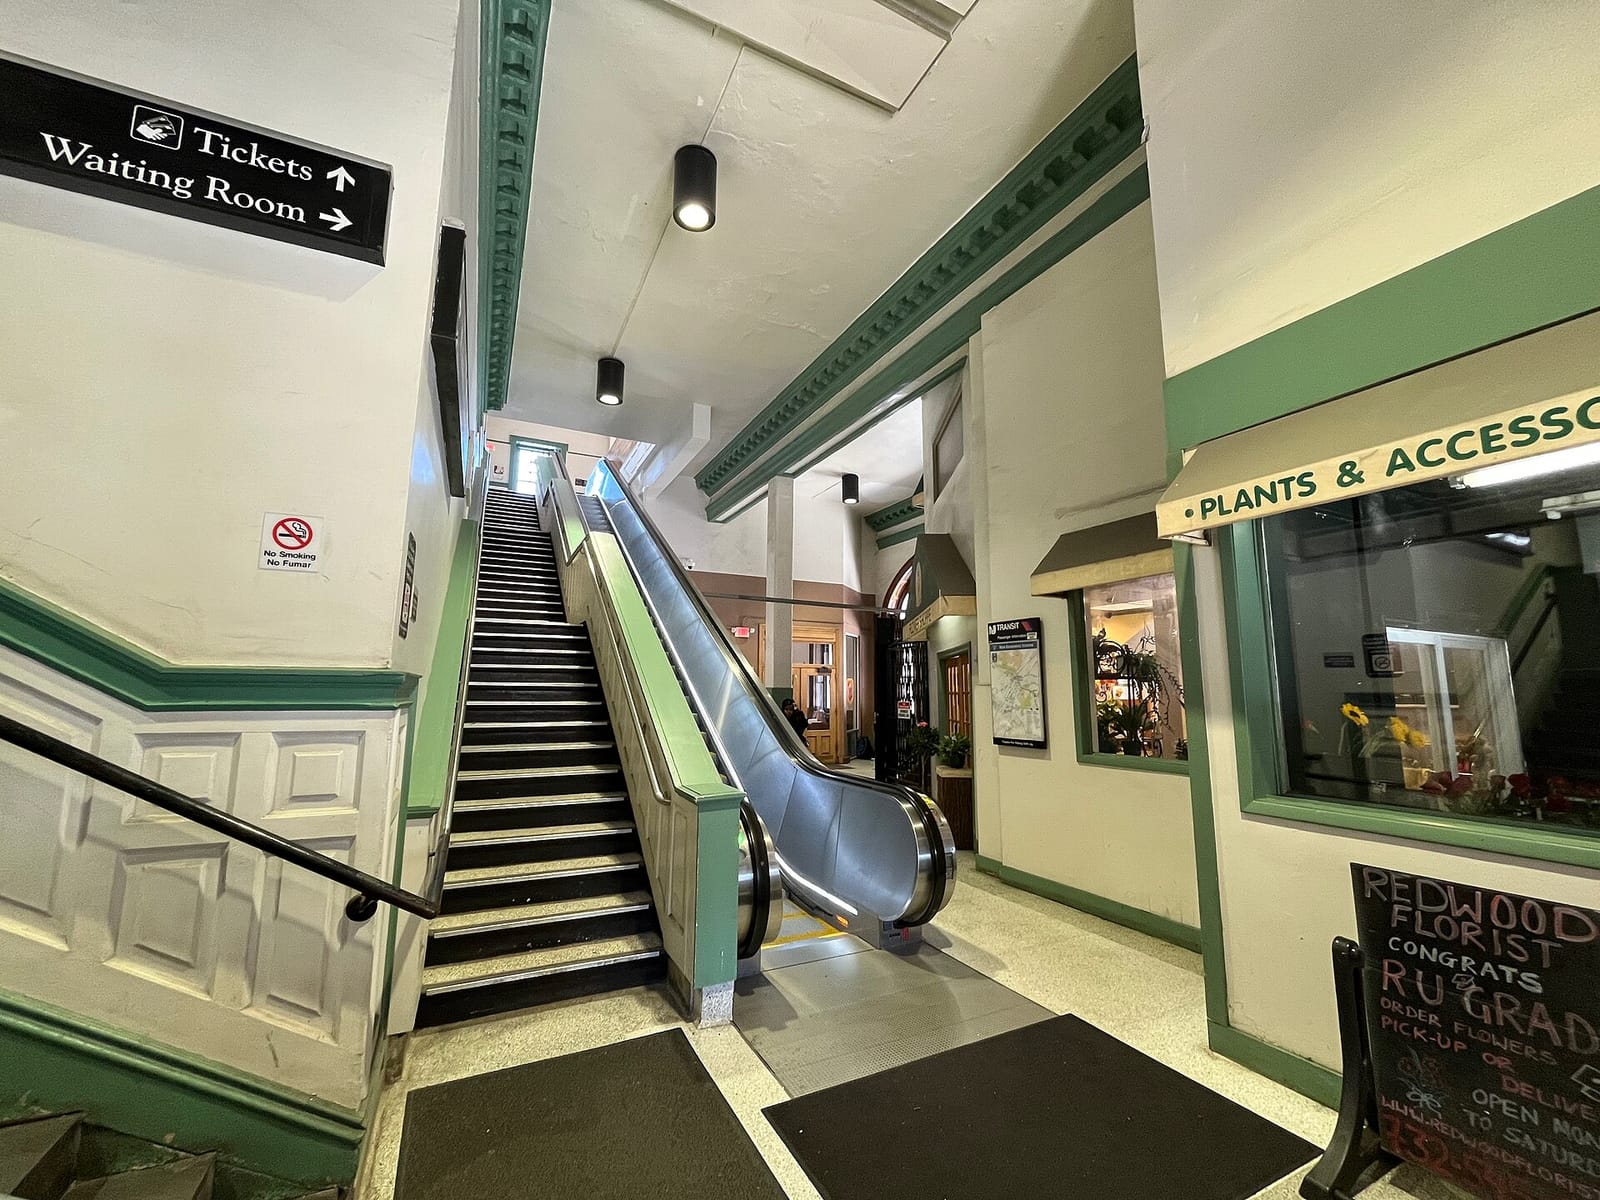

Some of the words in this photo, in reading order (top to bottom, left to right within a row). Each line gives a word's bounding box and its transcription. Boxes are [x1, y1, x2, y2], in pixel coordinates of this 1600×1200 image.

[39, 131, 194, 199] Waiting
[204, 175, 306, 224] Room
[193, 126, 313, 181] Tickets
[1201, 471, 1317, 520] PLANTS
[1336, 460, 1365, 488] &
[1385, 396, 1600, 477] ACCESSO
[279, 551, 317, 561] Smoking
[282, 560, 312, 568] Fumar
[996, 621, 1020, 631] TRANSIT
[1362, 866, 1600, 943] REDWOOD
[1388, 936, 1544, 994] CONGRATS
[1391, 904, 1563, 968] FLORIST
[1380, 996, 1442, 1028] ORDER
[1454, 1021, 1558, 1065] FLOWERS
[1382, 958, 1444, 1006] RU
[1463, 986, 1600, 1055] GRAD
[1380, 1015, 1468, 1053] PICK-UP
[1482, 1052, 1515, 1074] OR
[1463, 1109, 1492, 1131] TO
[1472, 1088, 1539, 1126] OPEN
